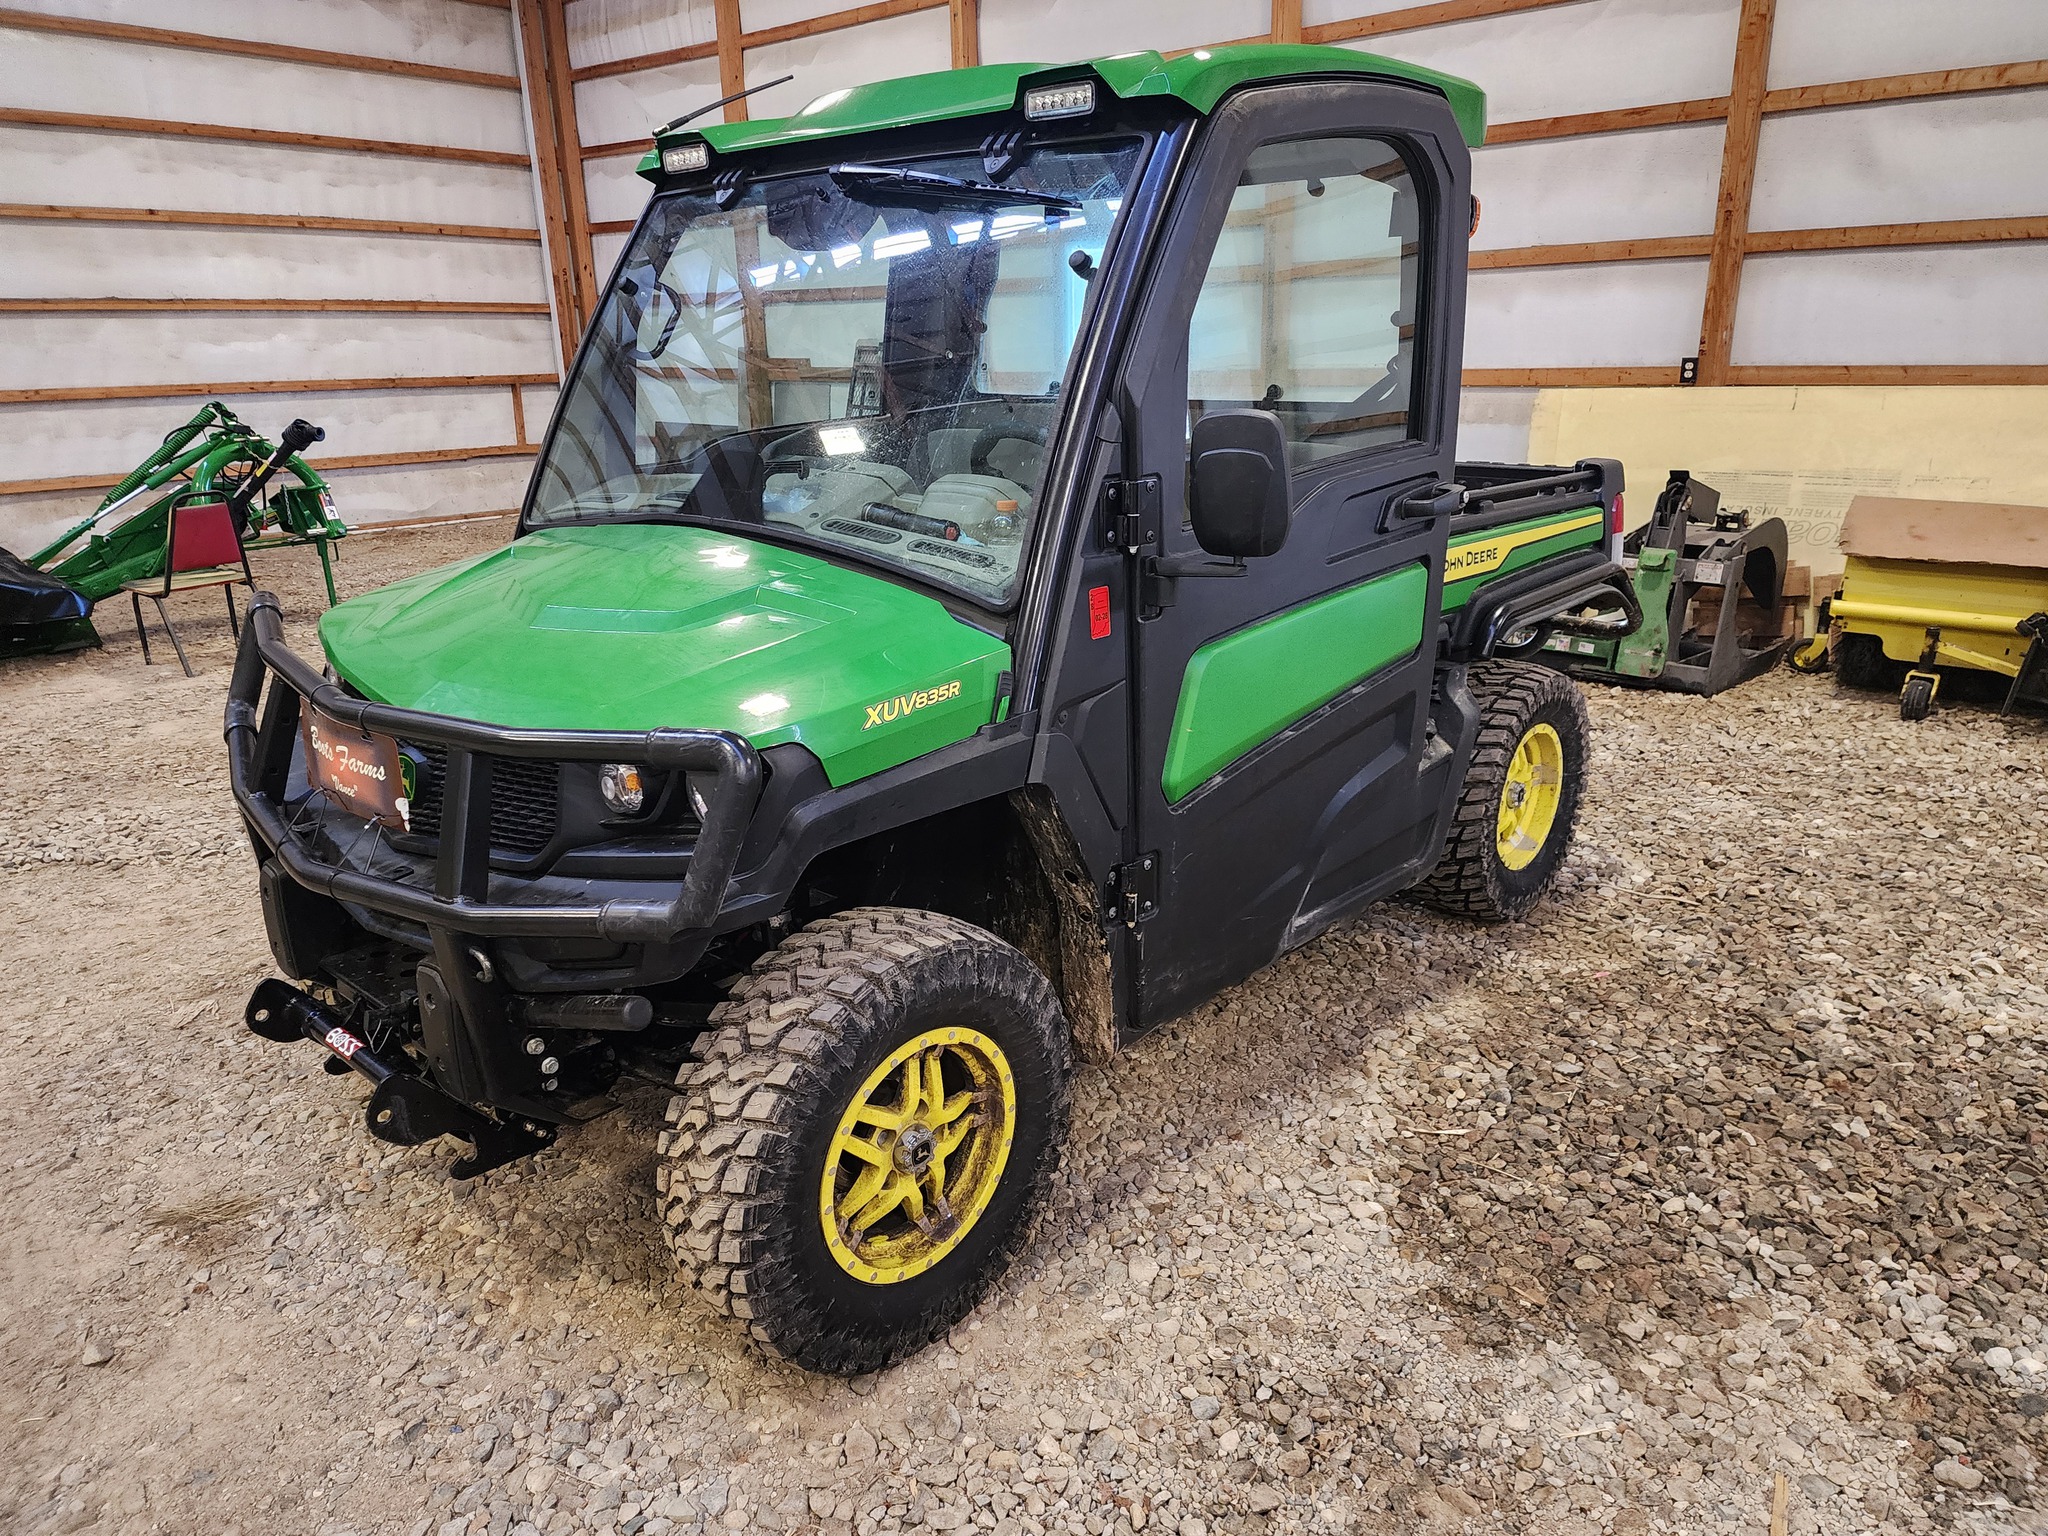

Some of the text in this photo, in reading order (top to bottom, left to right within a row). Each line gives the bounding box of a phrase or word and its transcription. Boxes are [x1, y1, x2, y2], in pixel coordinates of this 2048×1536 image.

[1783, 507, 1843, 519] TYRENE
[1444, 547, 1498, 572] OHN DEERE
[861, 680, 962, 731] XUV835R
[310, 725, 387, 781] Boots Farms
[325, 1027, 364, 1057] BOSS
